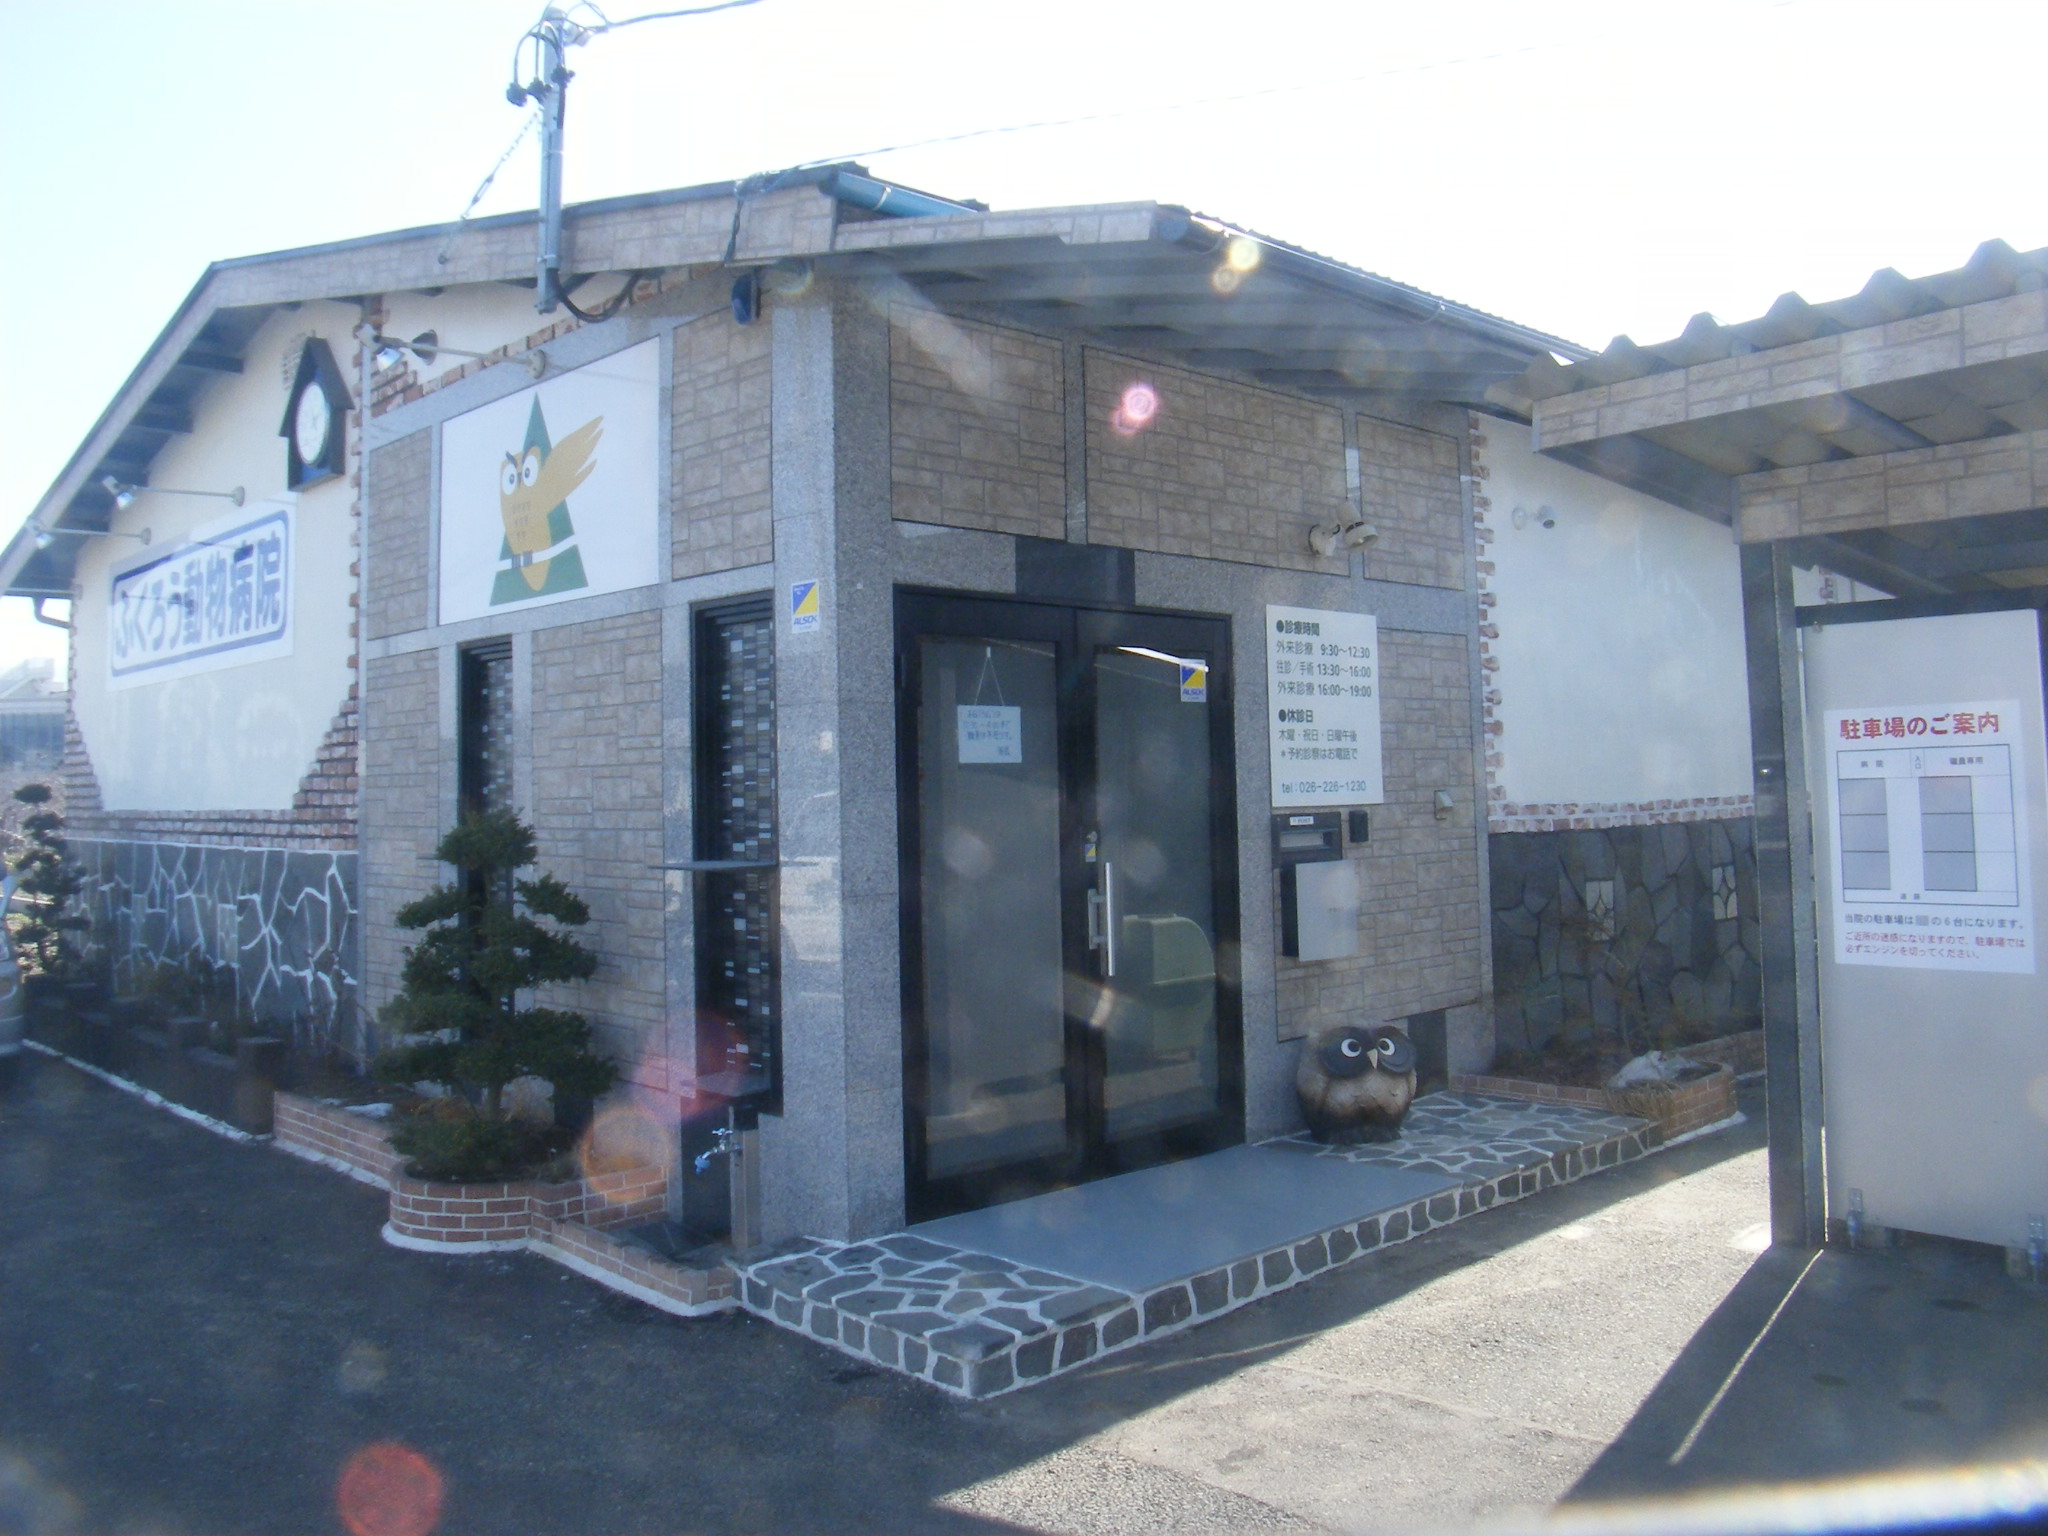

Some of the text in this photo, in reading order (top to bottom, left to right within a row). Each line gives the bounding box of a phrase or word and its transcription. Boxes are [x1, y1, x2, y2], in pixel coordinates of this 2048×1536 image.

[114, 530, 282, 658] ふくろう動物病院
[1285, 620, 1320, 636] 診療時間
[1276, 640, 1313, 655] 外来診療
[1277, 681, 1315, 696] 外来診療
[1287, 708, 1313, 723] 休診日
[1840, 712, 1999, 740] 駐車場のご案内
